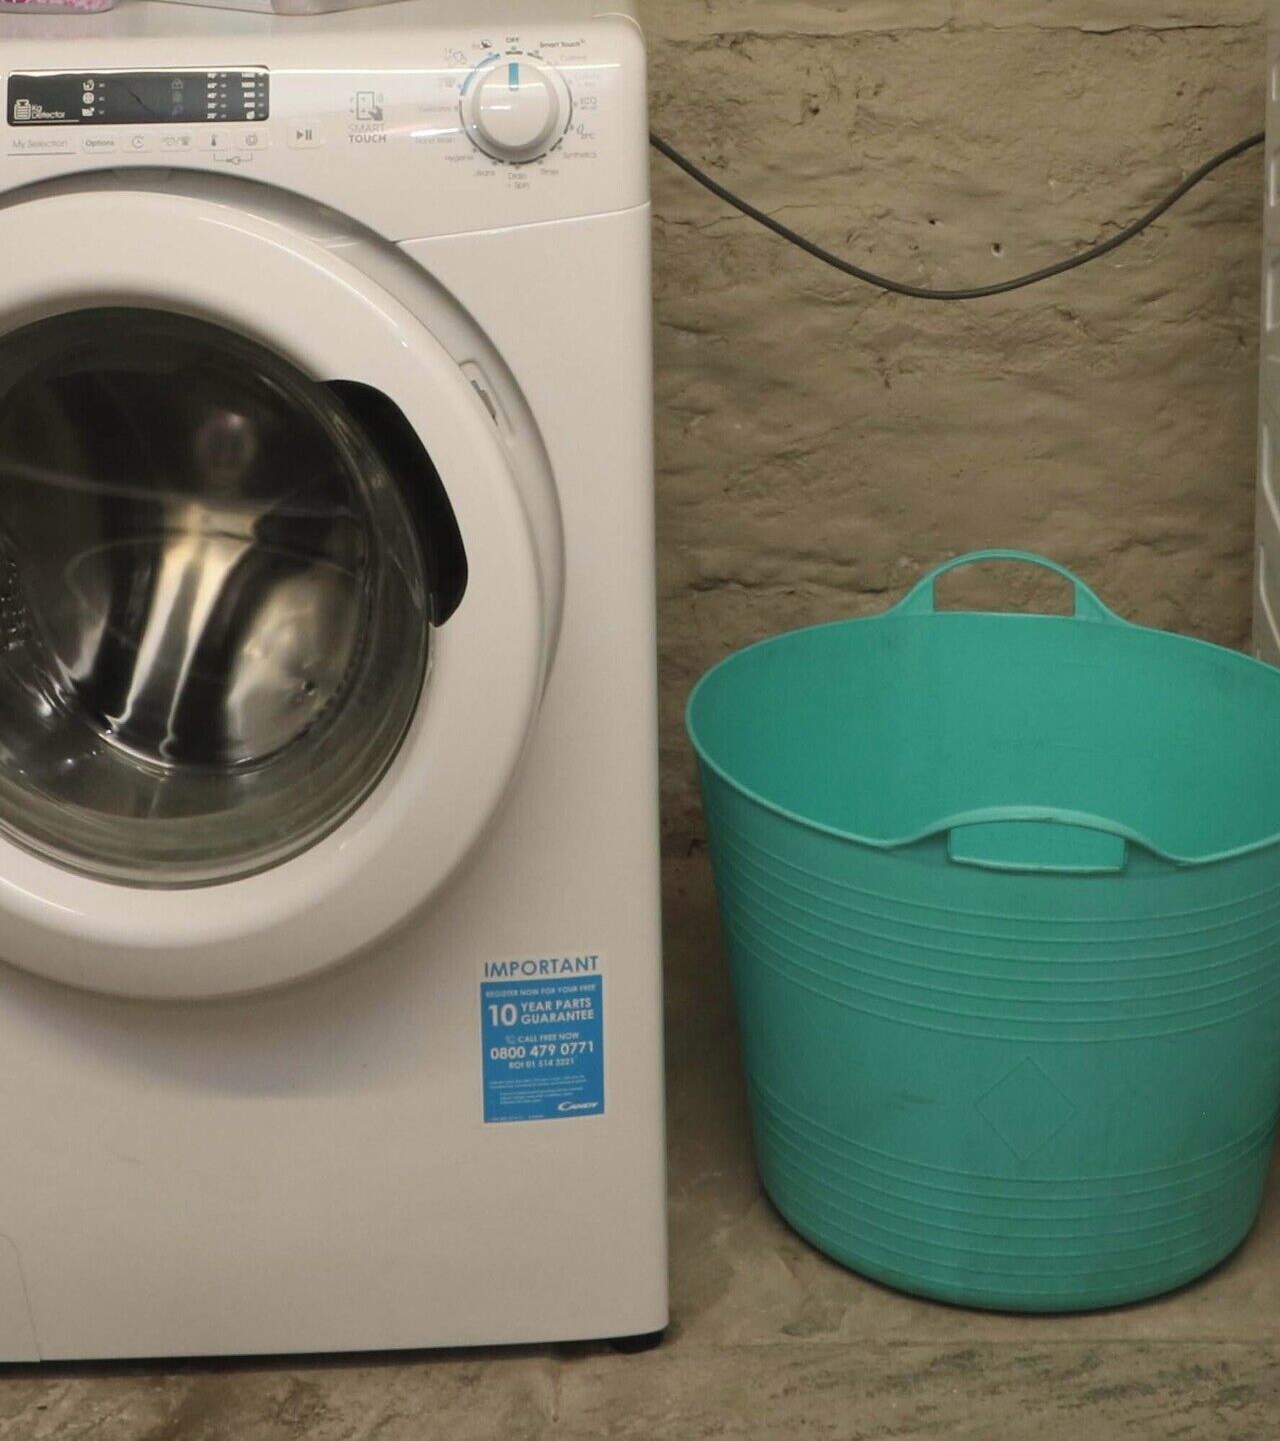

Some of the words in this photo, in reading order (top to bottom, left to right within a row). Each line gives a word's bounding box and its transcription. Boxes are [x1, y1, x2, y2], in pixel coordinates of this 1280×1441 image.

[32, 110, 65, 119] Detector
[348, 124, 384, 133] SMART
[12, 139, 25, 149] My
[28, 139, 68, 148] Selection
[85, 139, 114, 148] Options
[348, 135, 387, 143] TOUCH
[485, 955, 599, 977] IMPORTANT
[520, 988, 538, 996] NOW
[541, 987, 556, 995] FOR
[557, 986, 577, 994] YOUR
[521, 1000, 552, 1012] YEAR
[555, 998, 592, 1009] PARTS
[488, 1003, 517, 1026] 10
[521, 1009, 594, 1025] GUARANTEE
[517, 1034, 537, 1043] CALL
[540, 1033, 557, 1041] FREE
[559, 1032, 580, 1040] NOW
[490, 1046, 525, 1060] 0800
[529, 1044, 556, 1057] 479
[560, 1041, 594, 1055] 0771
